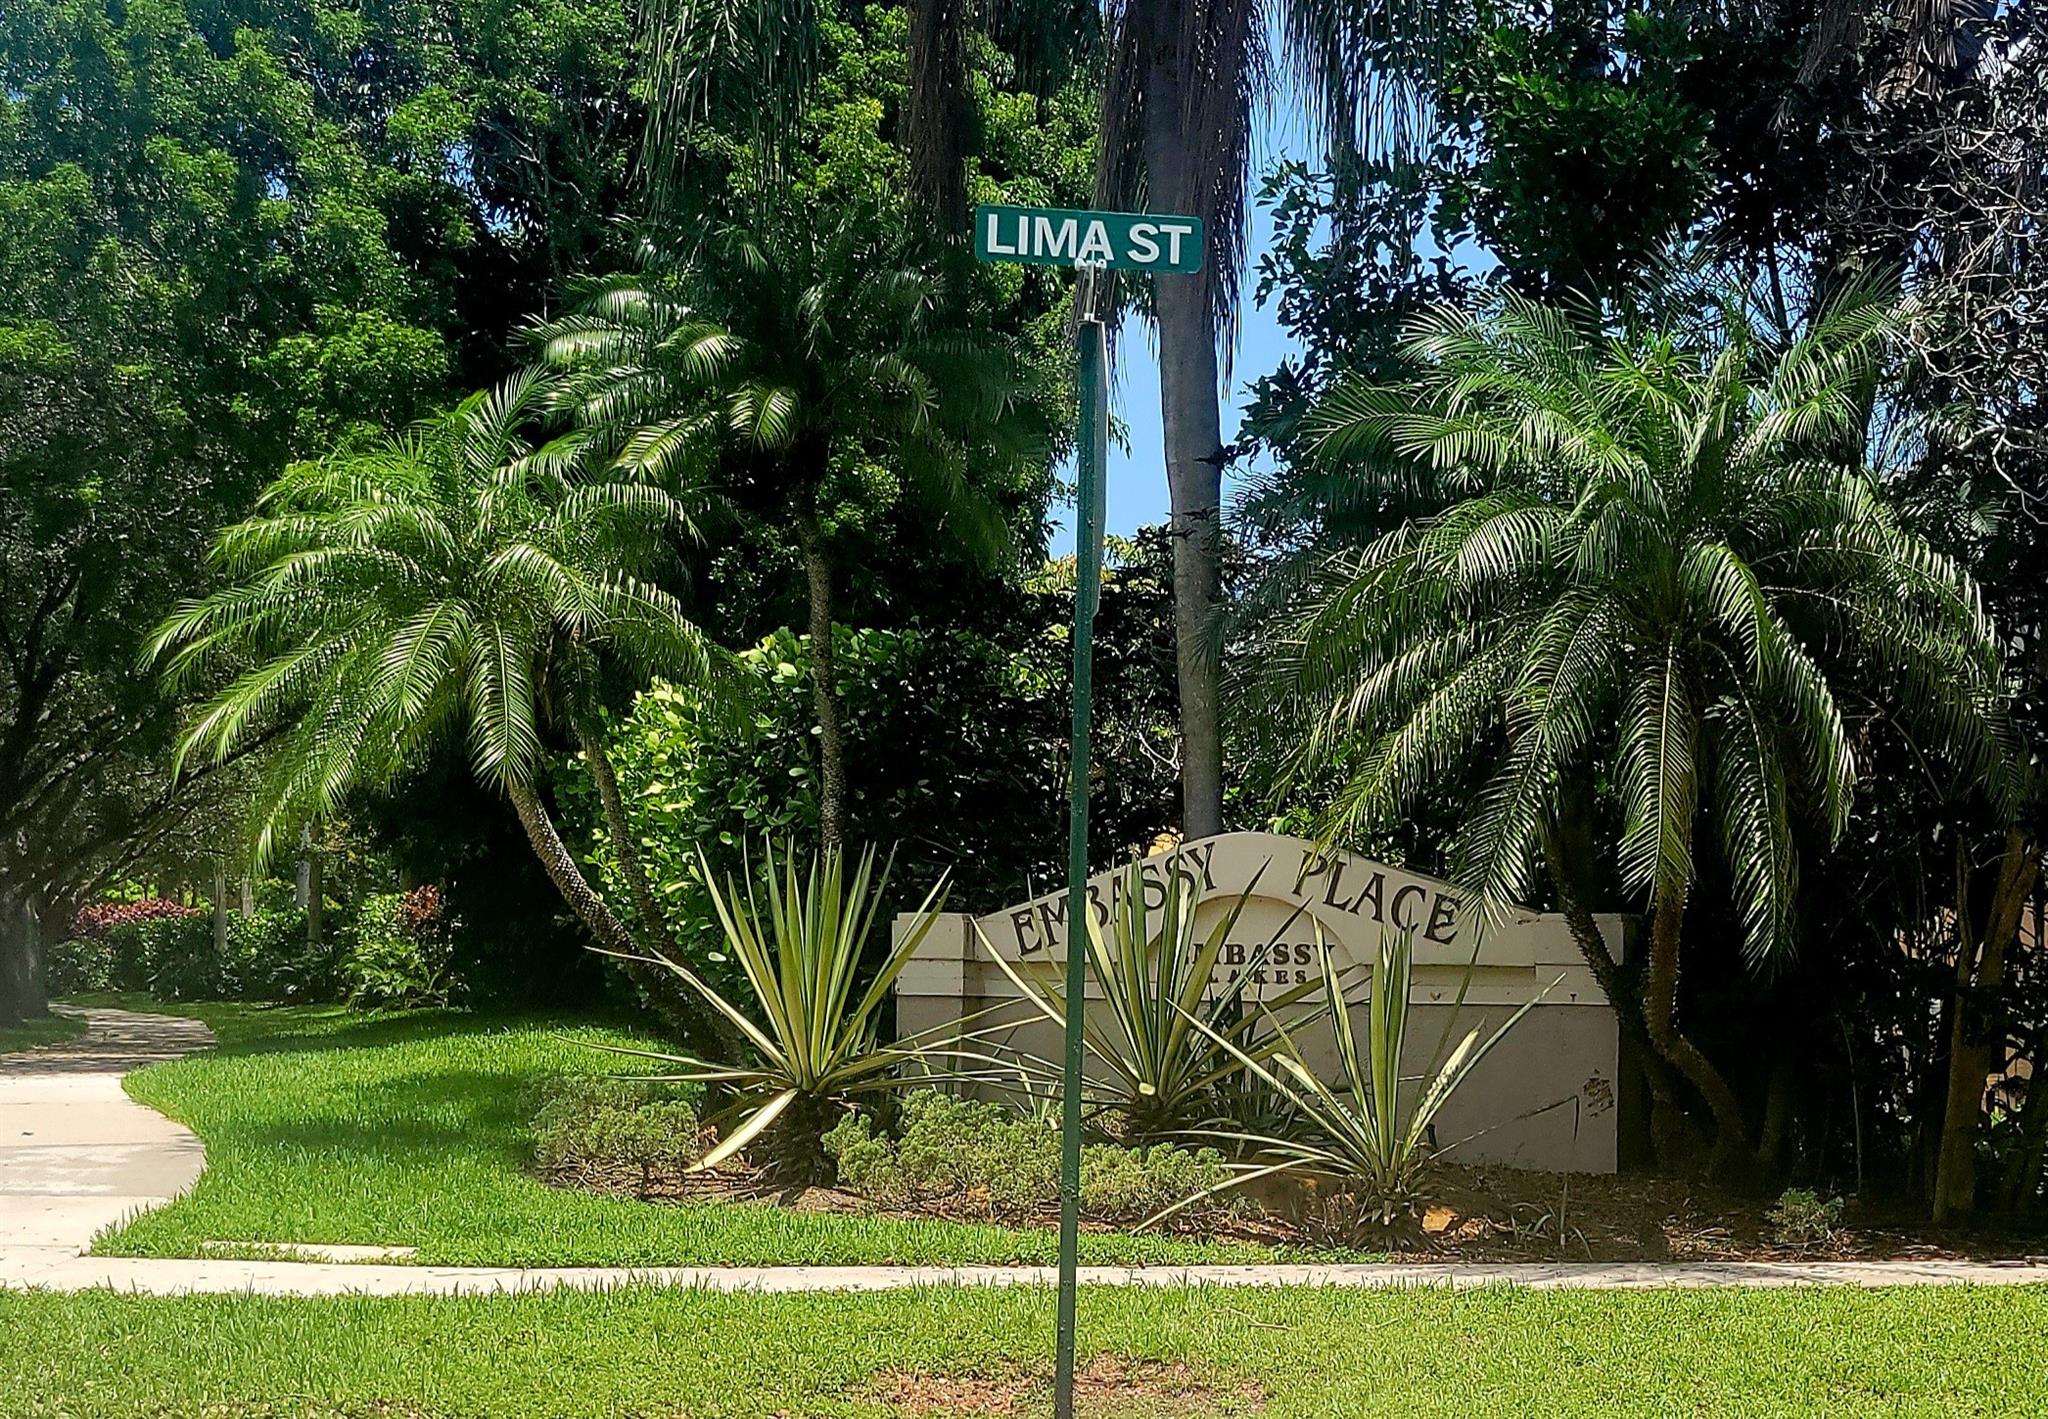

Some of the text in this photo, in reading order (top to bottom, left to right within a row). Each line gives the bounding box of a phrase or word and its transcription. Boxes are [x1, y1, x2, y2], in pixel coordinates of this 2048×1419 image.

[987, 213, 1193, 265] LIMA ST
[1291, 850, 1463, 945] PLACE
[1185, 943, 1336, 966] BASS
